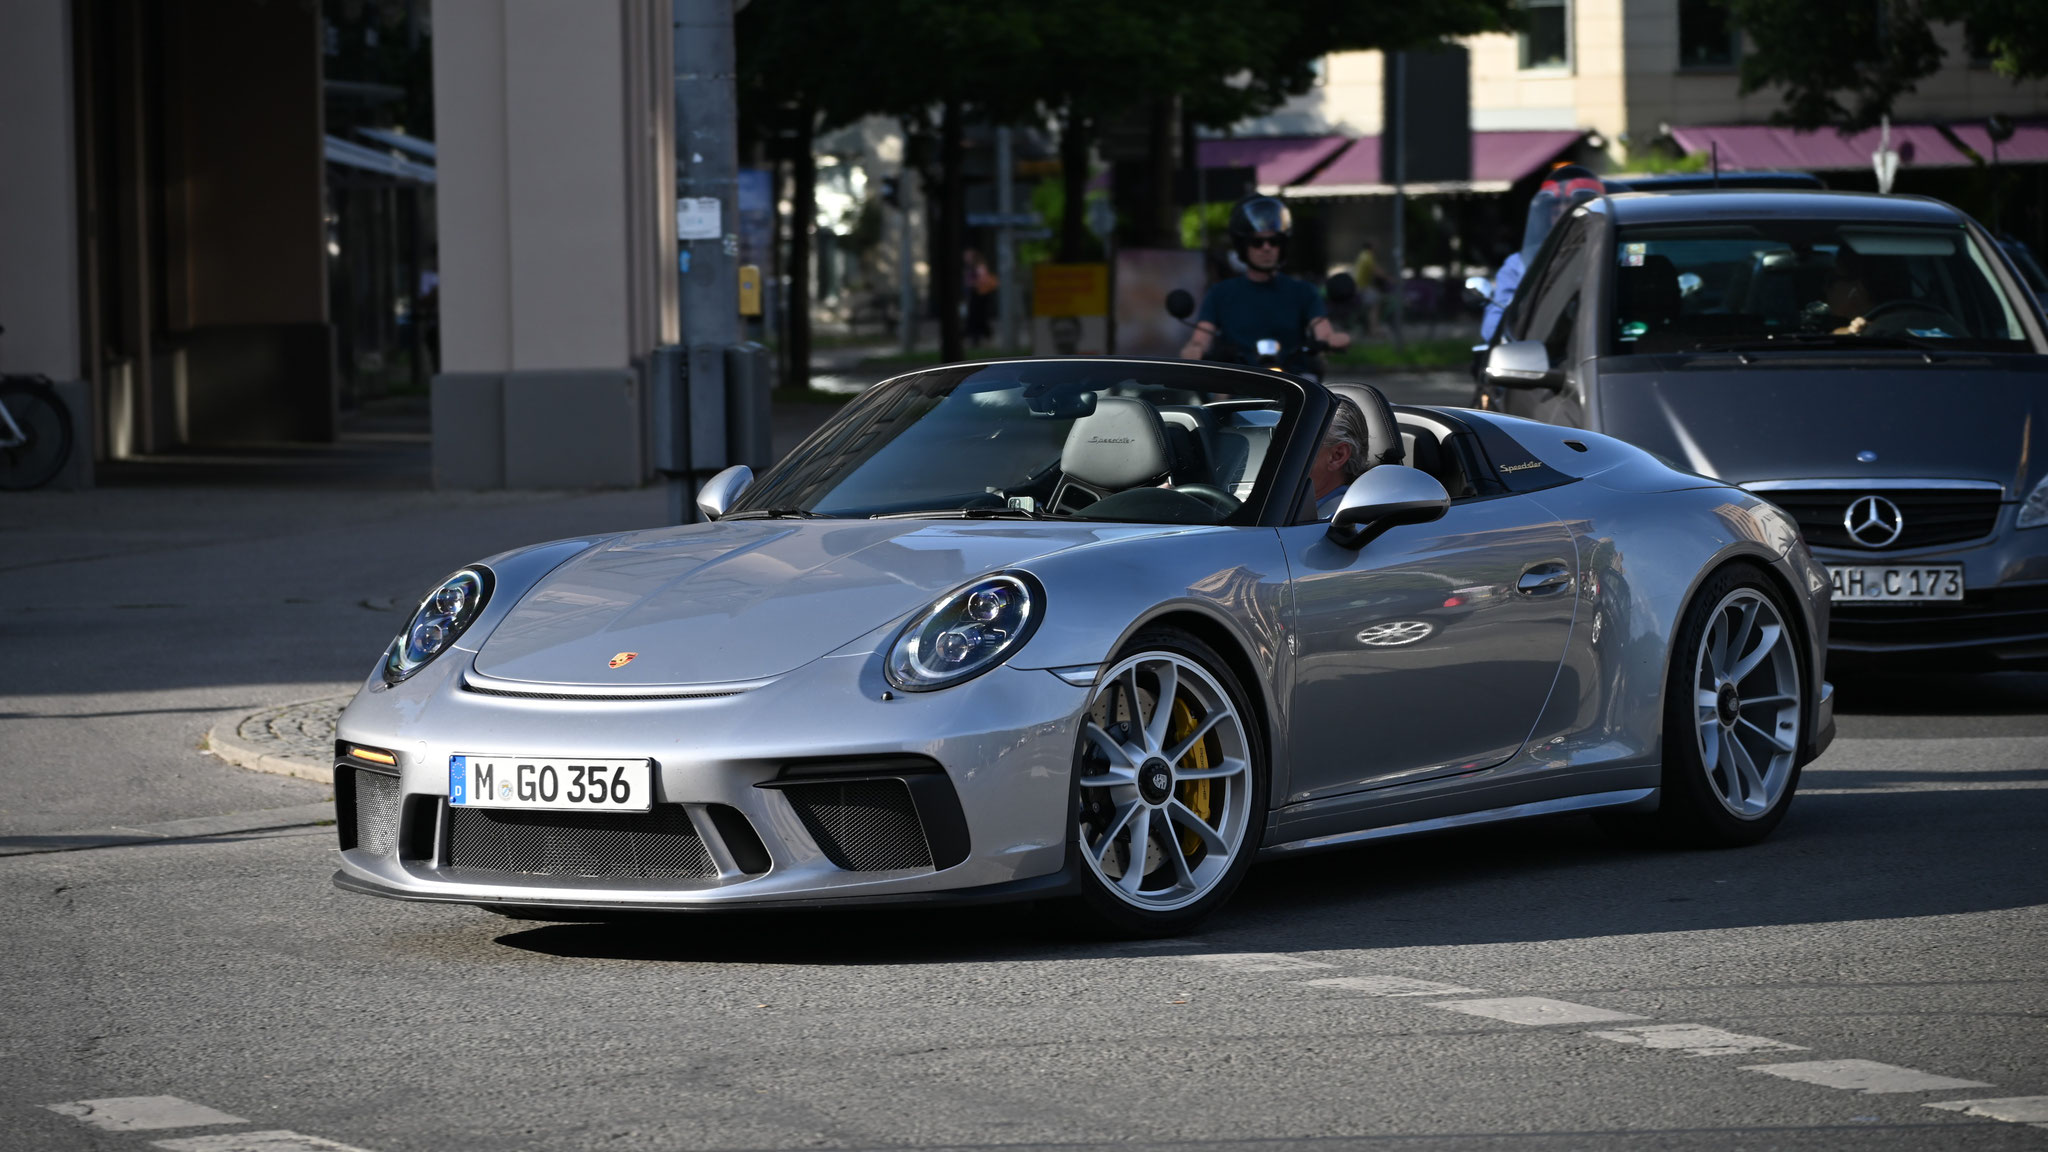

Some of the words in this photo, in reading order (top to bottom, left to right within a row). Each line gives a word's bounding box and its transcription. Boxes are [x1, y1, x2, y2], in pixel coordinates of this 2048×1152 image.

[1500, 461, 1542, 474] Speedster
[1832, 570, 1865, 596] AH
[1884, 570, 1902, 596] C
[1907, 570, 1960, 596] 173
[475, 763, 494, 800] M
[517, 764, 559, 802] GO
[567, 765, 631, 804] 356
[1199, 747, 1207, 801] PORCHE
[454, 785, 462, 797] D
